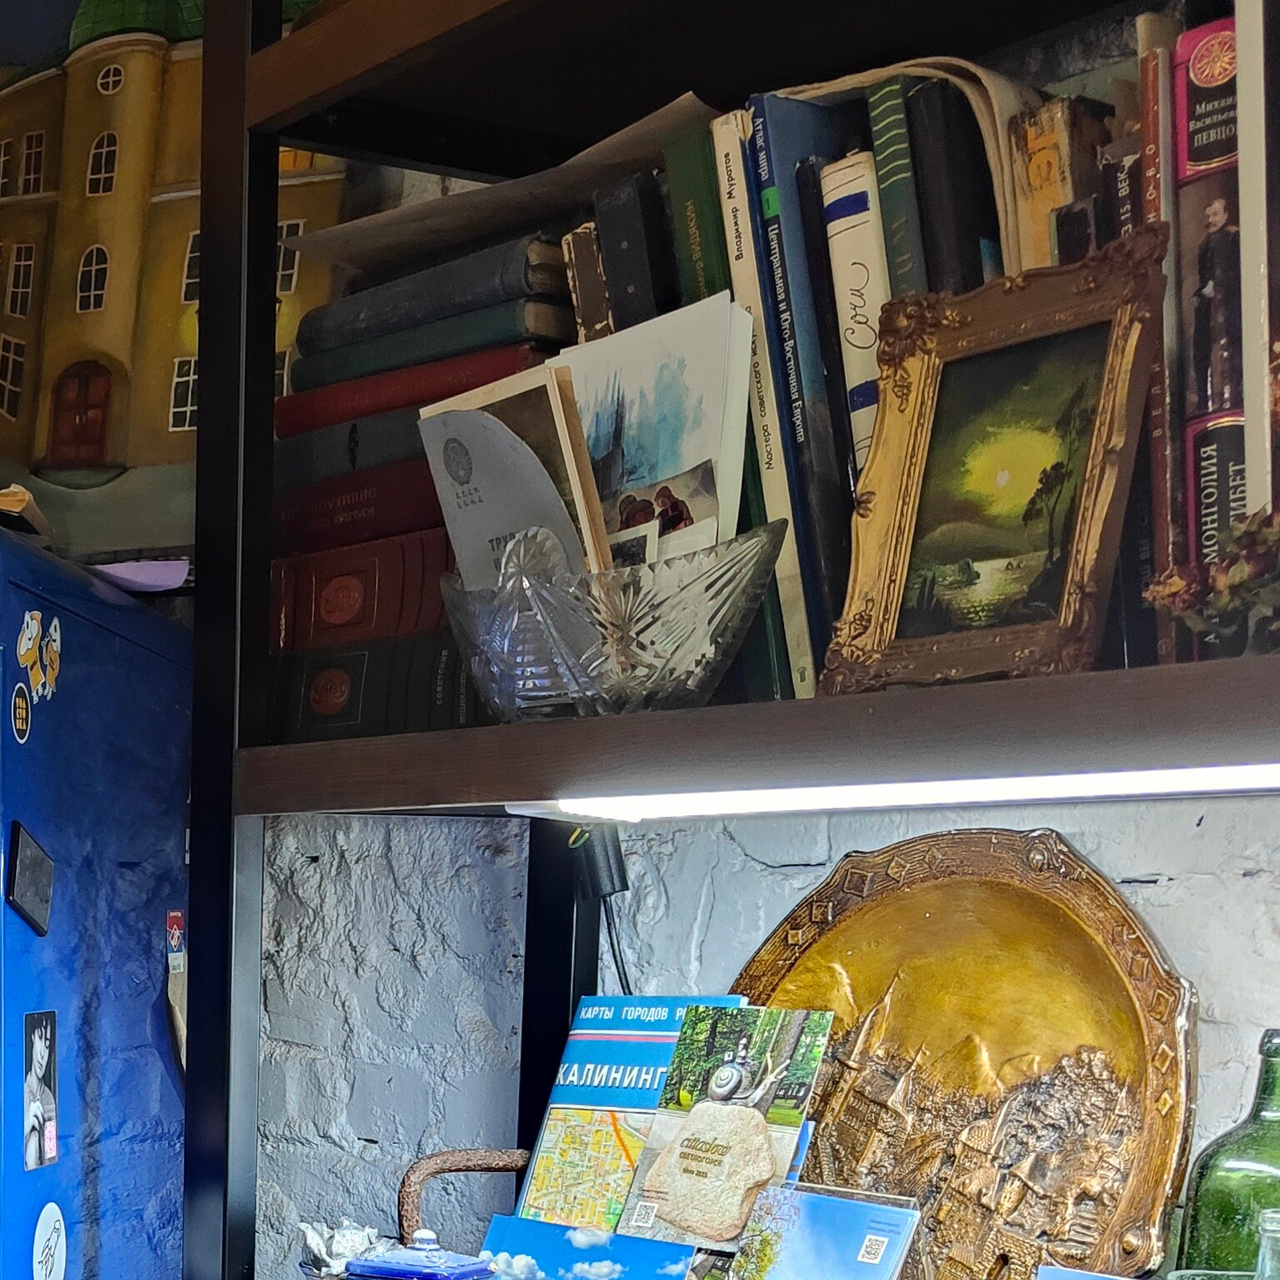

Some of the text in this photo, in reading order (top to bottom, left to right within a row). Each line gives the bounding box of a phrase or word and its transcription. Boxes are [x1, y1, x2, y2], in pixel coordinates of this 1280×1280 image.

[753, 117, 770, 182] Атлас мира
[723, 151, 745, 262] Владимир Муратов
[767, 223, 786, 301] Центральная
[779, 309, 799, 400] Юго-Восточная
[791, 399, 806, 444] Европа
[751, 361, 775, 471] Мастера советского
[1200, 443, 1219, 564] МОНГОЛИЯ
[579, 1006, 614, 1021] КАРТЫ
[621, 1006, 670, 1022] ГОРОДОВ
[678, 1151, 723, 1168] СВЕТЛОГОРСК
[679, 1132, 732, 1158] cittaslow
